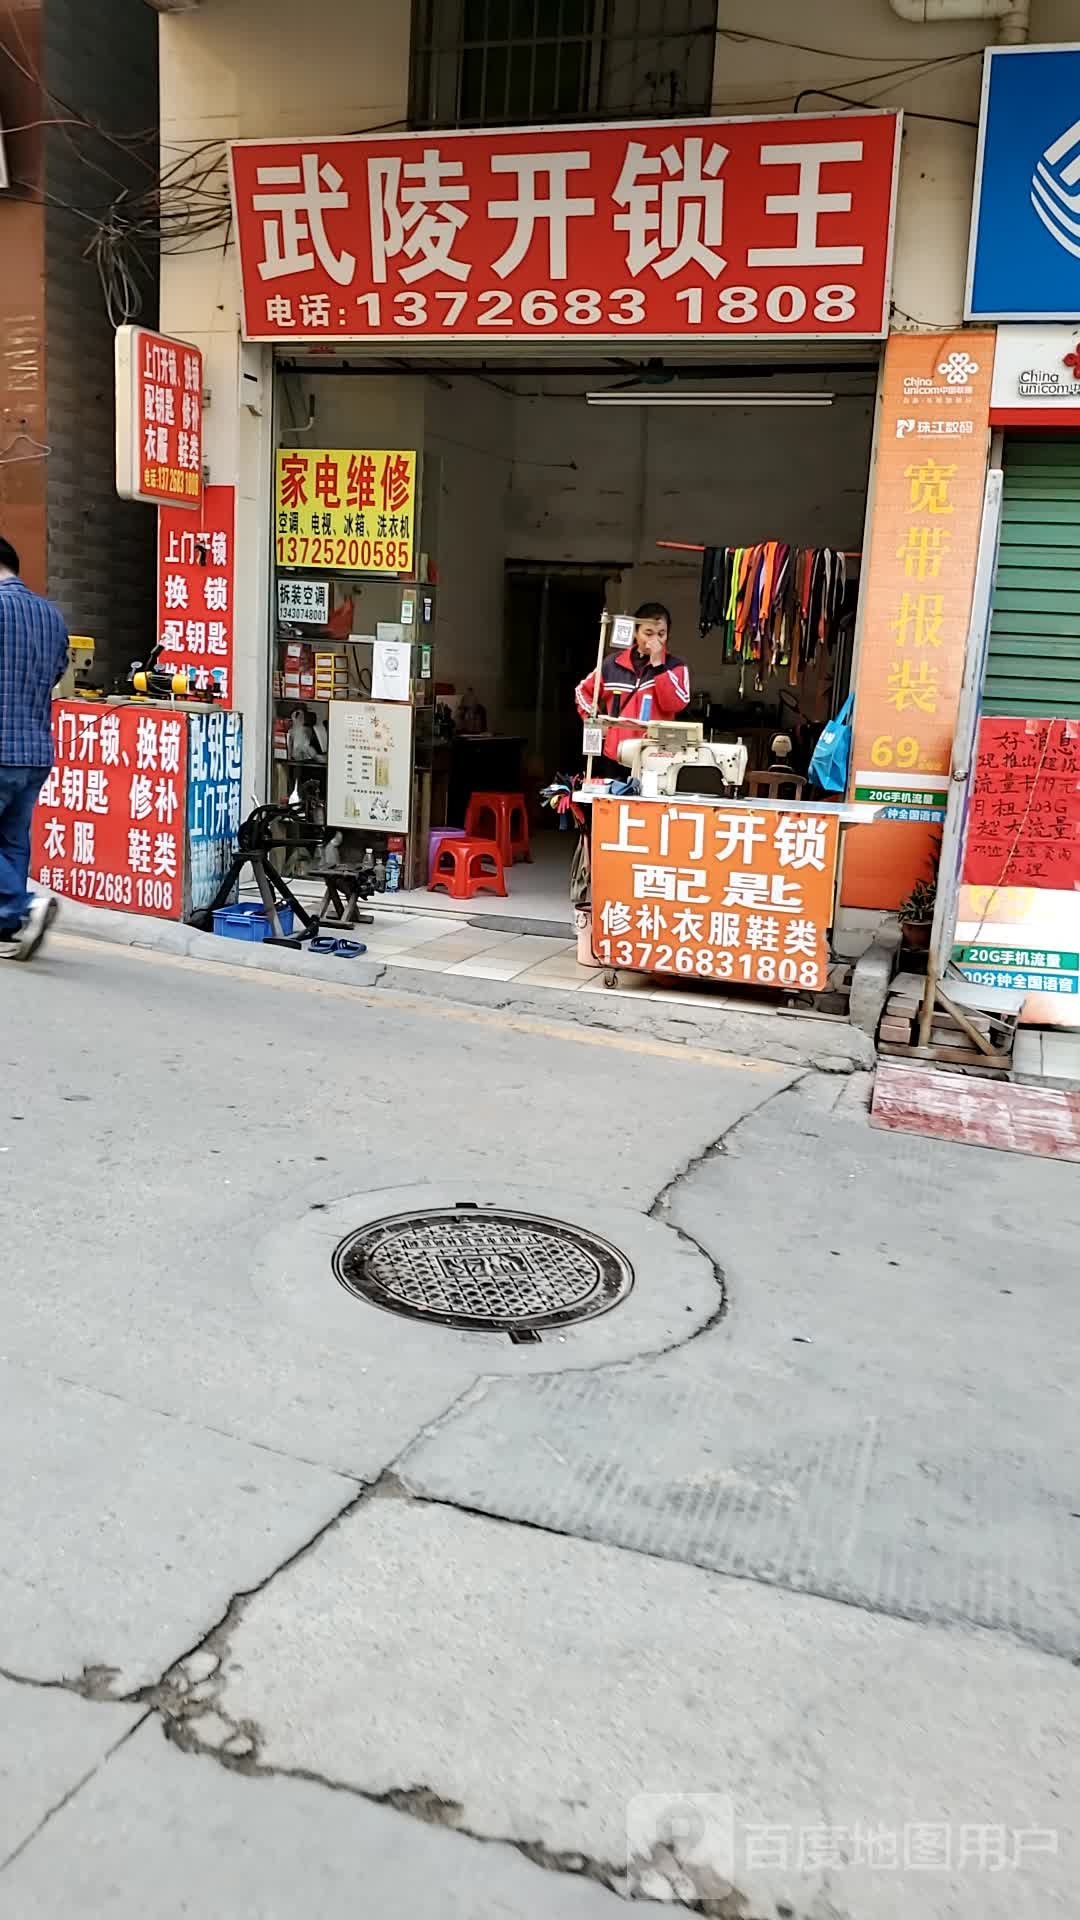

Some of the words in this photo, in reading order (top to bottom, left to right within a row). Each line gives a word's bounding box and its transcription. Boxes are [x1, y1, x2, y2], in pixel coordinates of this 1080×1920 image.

[253, 137, 863, 286] 武陵开锁王
[676, 284, 856, 326] 1808
[903, 377, 933, 387] China
[1020, 370, 1059, 383] China
[280, 453, 411, 512] 家电维修
[278, 511, 410, 539] 空调、电视、冰箱、洗衣机
[164, 531, 227, 566] 上门开锁
[277, 537, 409, 568] 13725200585
[279, 584, 325, 607] 拆装空调
[886, 458, 959, 713] 宽带报装
[279, 607, 326, 621] 13430748001
[161, 620, 228, 655] 配钥匙
[190, 713, 241, 782] 配钥匙
[870, 735, 920, 768] 69
[992, 728, 1077, 756] 好消息
[38, 766, 109, 815] 配钥匙
[129, 773, 178, 824] 修补
[190, 782, 241, 836] 上门开锁
[868, 790, 934, 805] 20G手机流量
[44, 817, 95, 865] 衣服
[127, 827, 177, 878] 鞋类
[600, 804, 828, 872] 上门开锁
[136, 877, 172, 910] 1808
[599, 900, 817, 957] 修补衣服鞋类
[598, 940, 820, 988] 13726831808
[968, 949, 1062, 968] 20G手机流量
